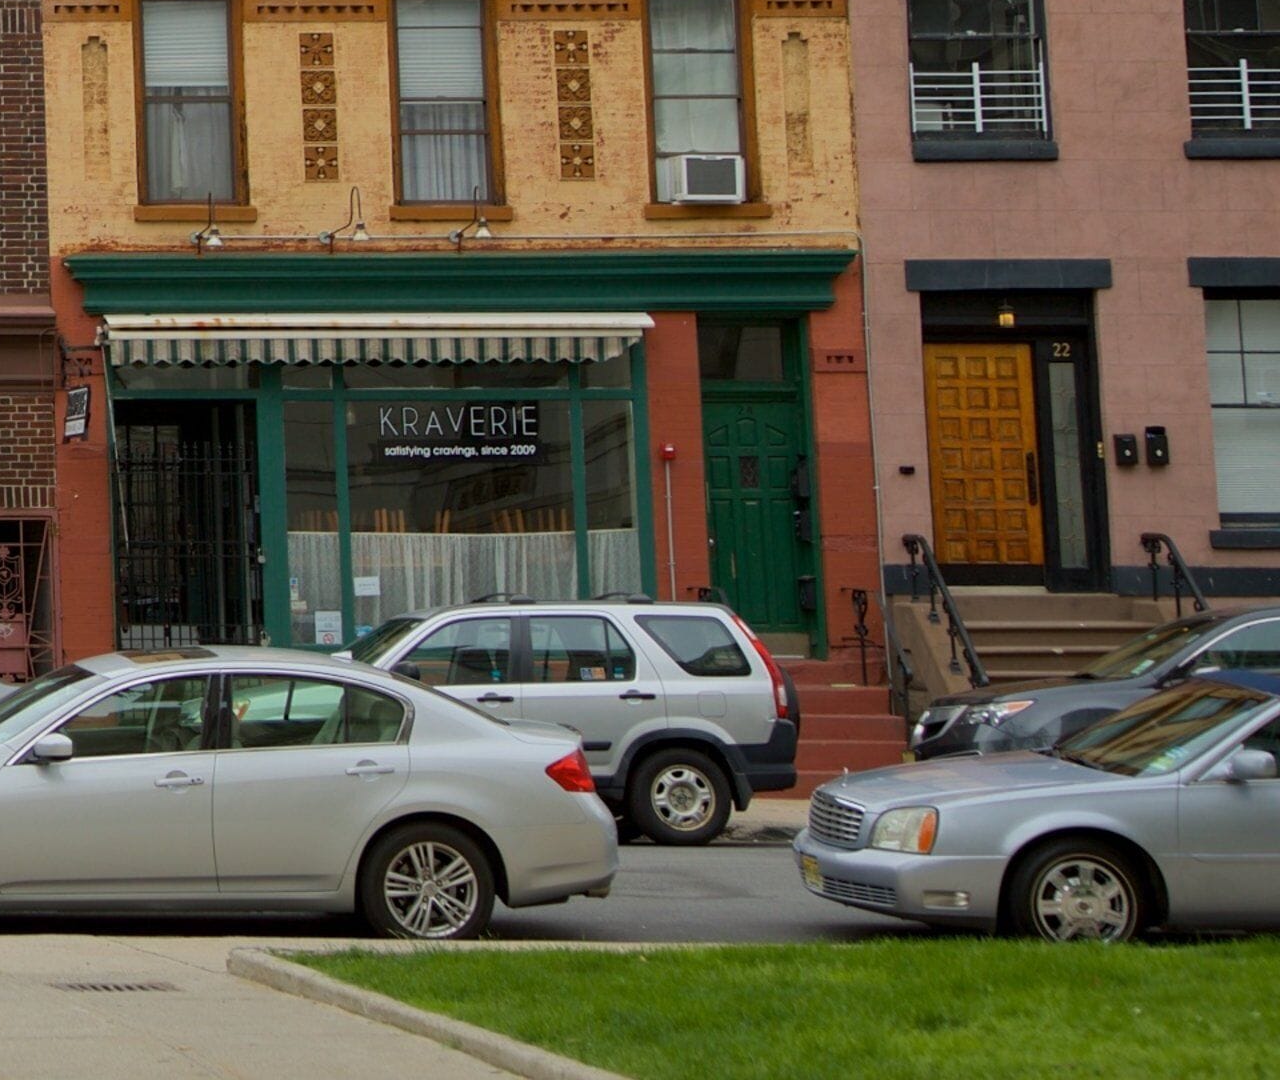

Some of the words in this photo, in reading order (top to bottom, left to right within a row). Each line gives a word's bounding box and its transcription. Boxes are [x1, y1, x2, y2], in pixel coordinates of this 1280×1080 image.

[1052, 342, 1071, 357] 22
[379, 406, 538, 436] KRAVERIE
[384, 445, 431, 458] satisfying
[432, 445, 479, 458] cravings,
[481, 445, 508, 456] since
[510, 444, 536, 456] 2009
